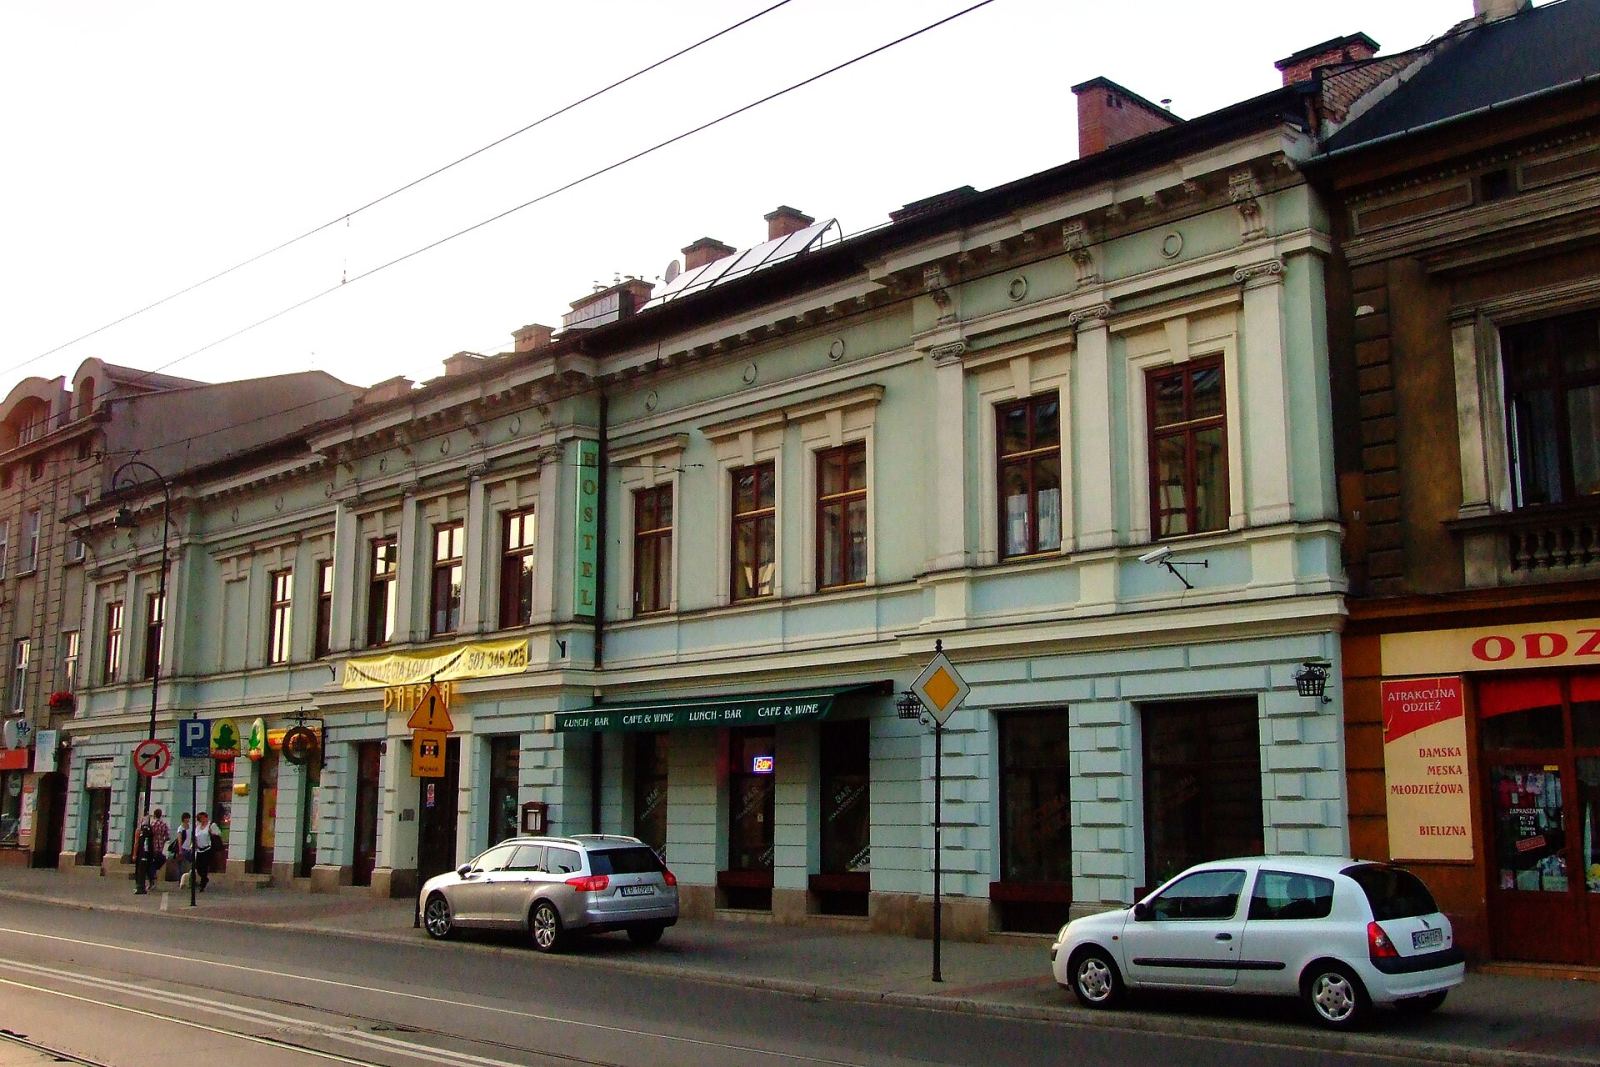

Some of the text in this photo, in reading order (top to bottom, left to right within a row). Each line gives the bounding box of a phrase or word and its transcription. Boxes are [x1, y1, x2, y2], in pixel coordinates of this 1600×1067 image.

[581, 452, 597, 606] HOSTEL
[468, 651, 485, 670] 501
[507, 647, 525, 668] 225
[1387, 688, 1456, 702] ATRAKCYJNA
[689, 710, 718, 721] LUNCH
[724, 709, 742, 719] BAR
[757, 703, 819, 717] CAFE & WINE
[563, 718, 589, 728] LUNCH
[594, 717, 609, 727] BAR
[623, 713, 674, 725] CAFE & WINE
[186, 722, 205, 747] P
[1419, 747, 1462, 758] DAMSKA
[756, 758, 772, 770] Bar
[1419, 824, 1467, 836] BIELIZNA
